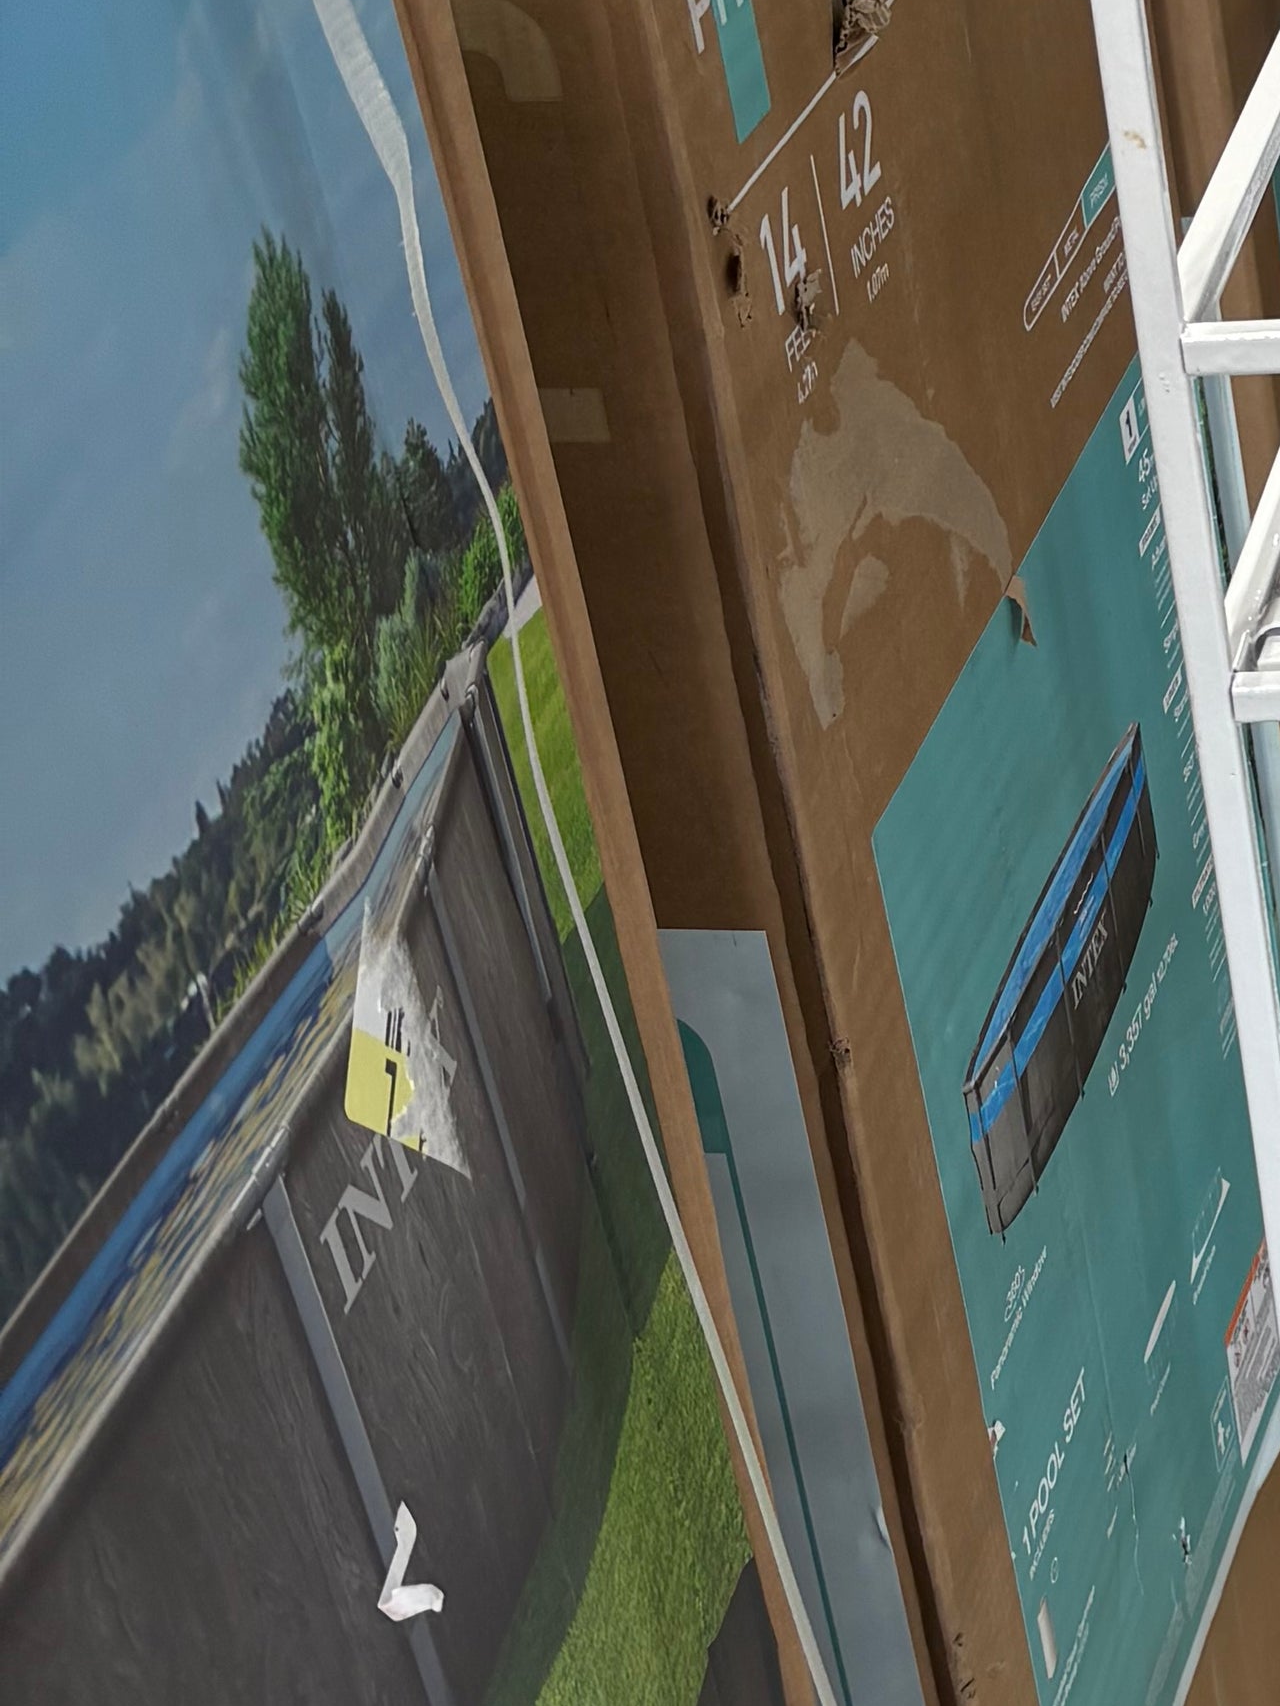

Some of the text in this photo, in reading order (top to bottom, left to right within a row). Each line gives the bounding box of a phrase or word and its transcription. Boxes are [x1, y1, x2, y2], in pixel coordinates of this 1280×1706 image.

[838, 89, 882, 211] 42
[759, 185, 807, 317] 14
[850, 195, 896, 280] INCHES
[1118, 1001, 1144, 1072] 3,357
[1022, 1365, 1086, 1556] 1 POOL SET
